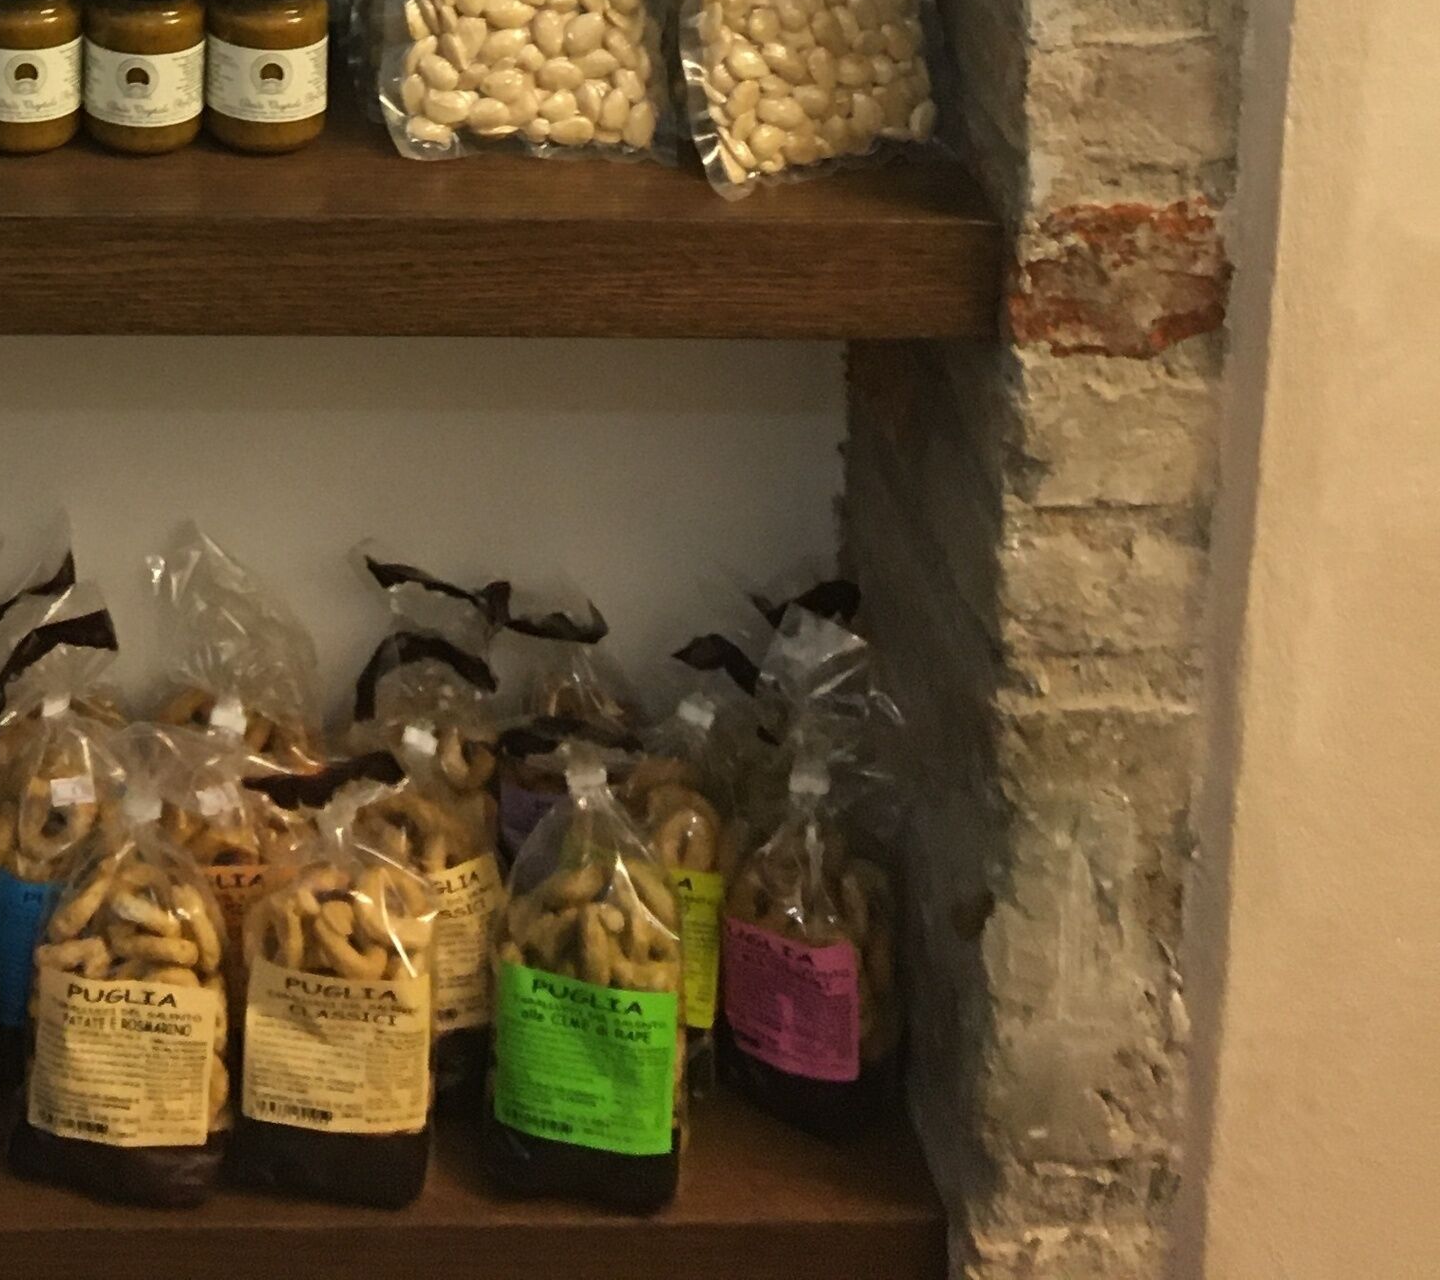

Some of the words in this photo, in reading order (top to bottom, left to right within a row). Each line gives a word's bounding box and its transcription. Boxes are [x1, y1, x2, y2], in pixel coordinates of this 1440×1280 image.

[66, 982, 177, 1009] PUGLIA
[285, 976, 398, 1003] PUGLIA
[531, 978, 643, 1016] PUGLIA
